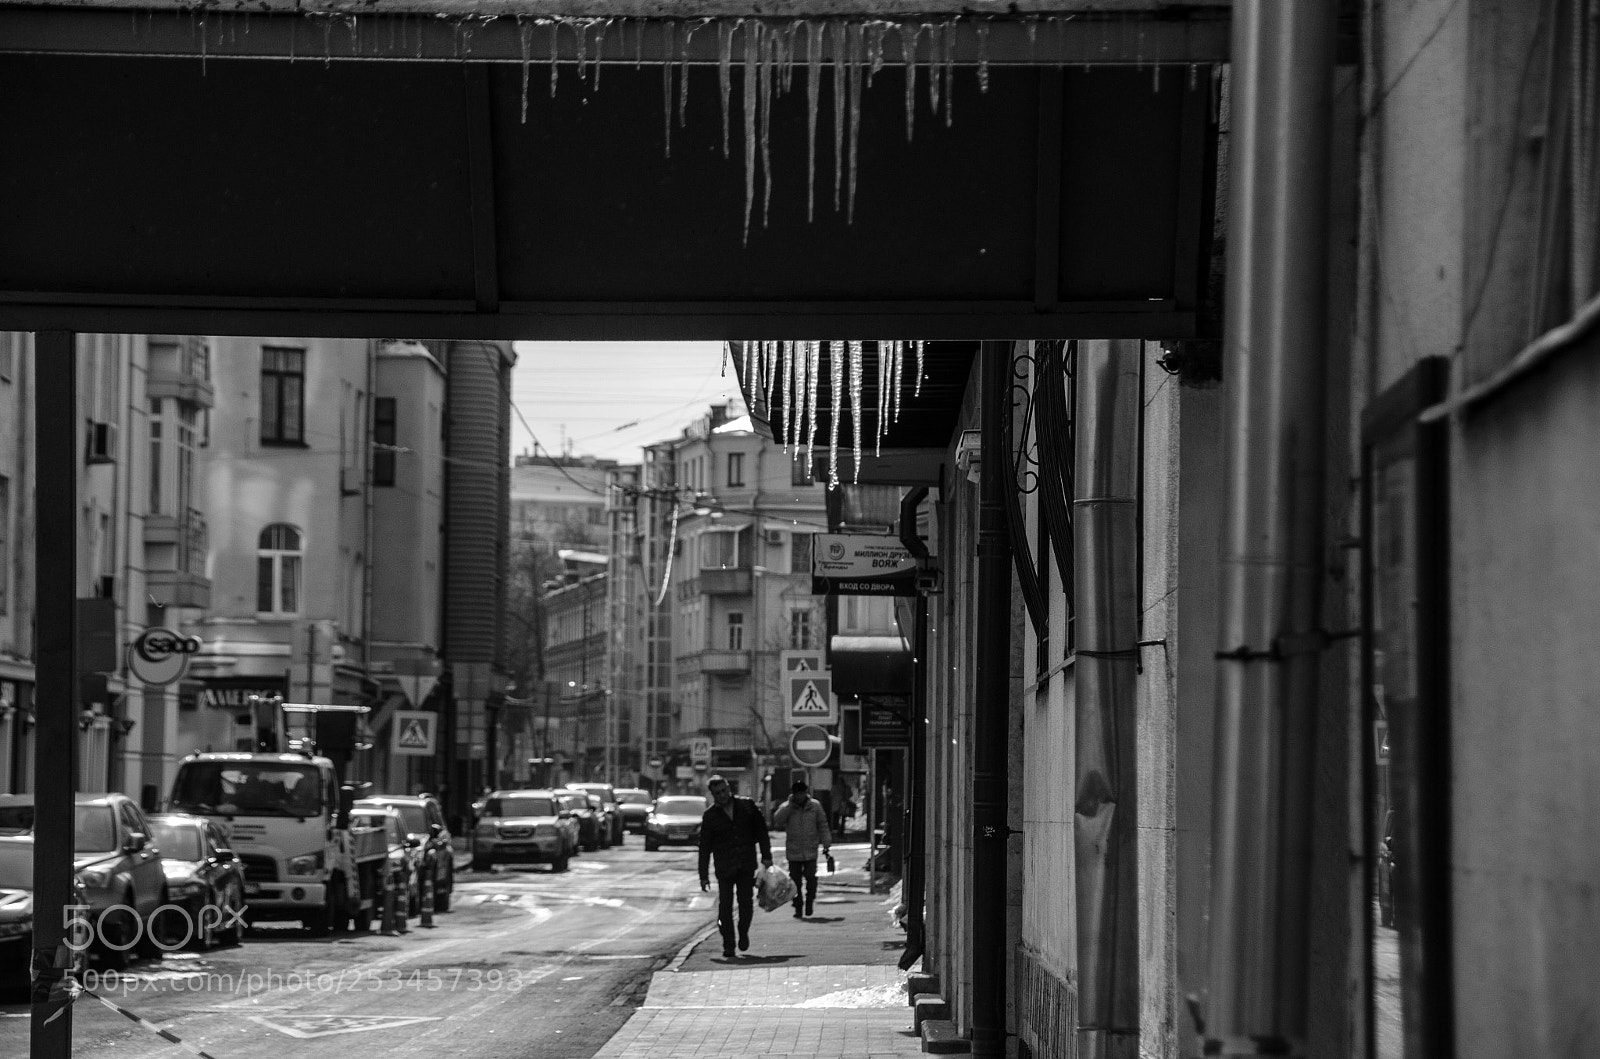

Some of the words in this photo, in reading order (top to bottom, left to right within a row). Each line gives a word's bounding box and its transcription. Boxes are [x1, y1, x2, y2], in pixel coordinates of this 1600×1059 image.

[854, 550, 886, 559] МИЛЛИОН
[871, 558, 898, 568] ВОЯЖ
[839, 582, 858, 590] ВХОД
[870, 583, 895, 591] ДВОРА
